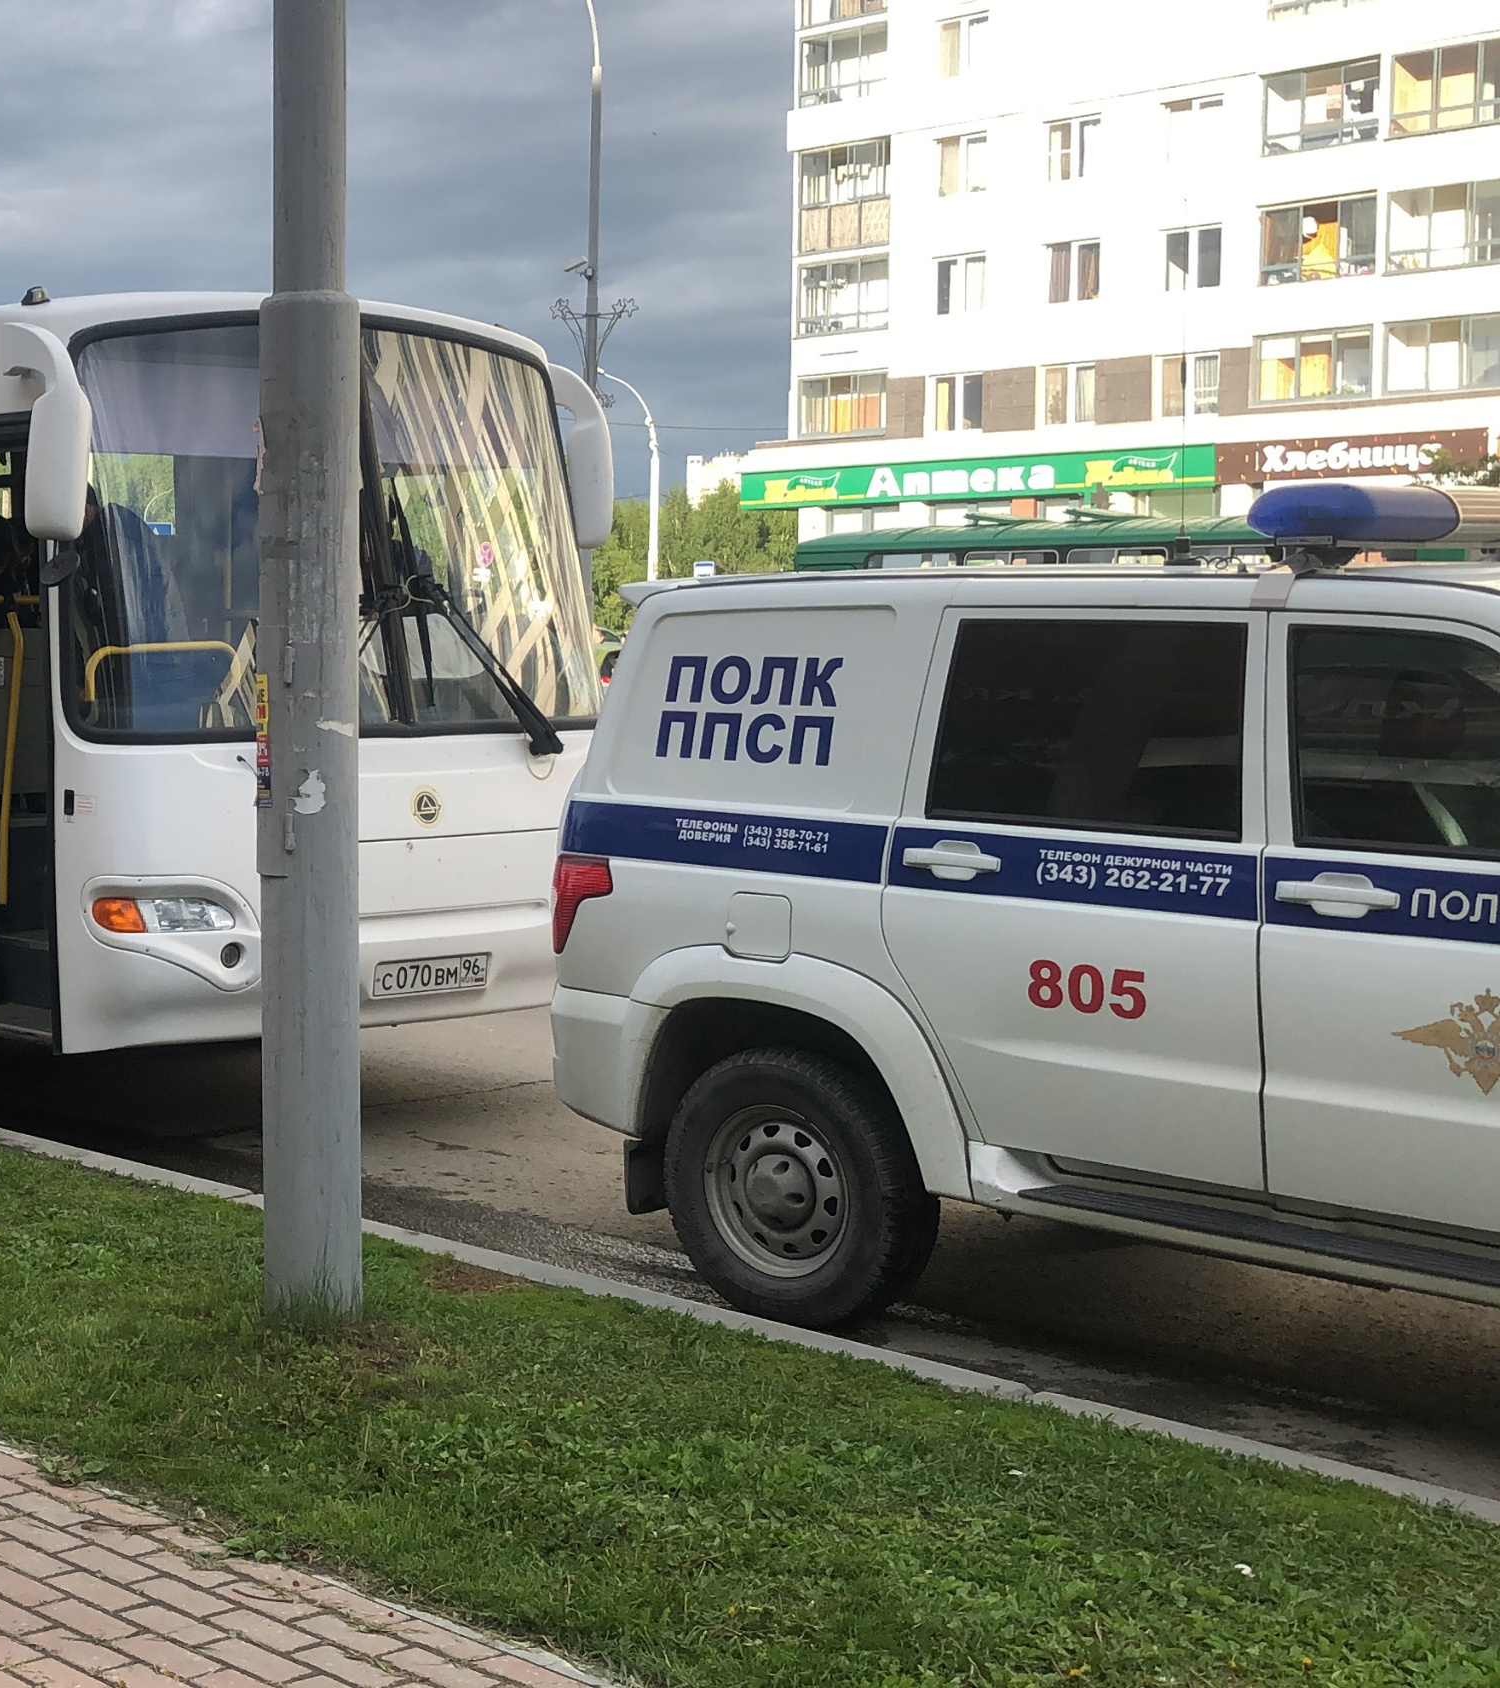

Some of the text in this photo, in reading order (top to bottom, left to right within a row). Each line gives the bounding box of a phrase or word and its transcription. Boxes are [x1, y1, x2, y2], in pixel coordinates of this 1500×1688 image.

[865, 464, 1055, 498] Аптека
[665, 655, 844, 707] ПОЛК
[655, 710, 835, 766] ППСП
[676, 818, 829, 842] ТЕЛЕФОНЫ (343) 358-70-71
[678, 829, 827, 853] ДОВЕРИЯ (343) 358-71-61
[1036, 862, 1231, 897] (343) 262-21-77
[1039, 849, 1101, 864] ТЕЛЕФОН
[1185, 861, 1233, 876] ЧАСТИ
[1411, 888, 1498, 924] ПОЛ
[381, 958, 480, 991] С070ВМ 96
[1028, 959, 1147, 1020] 805
